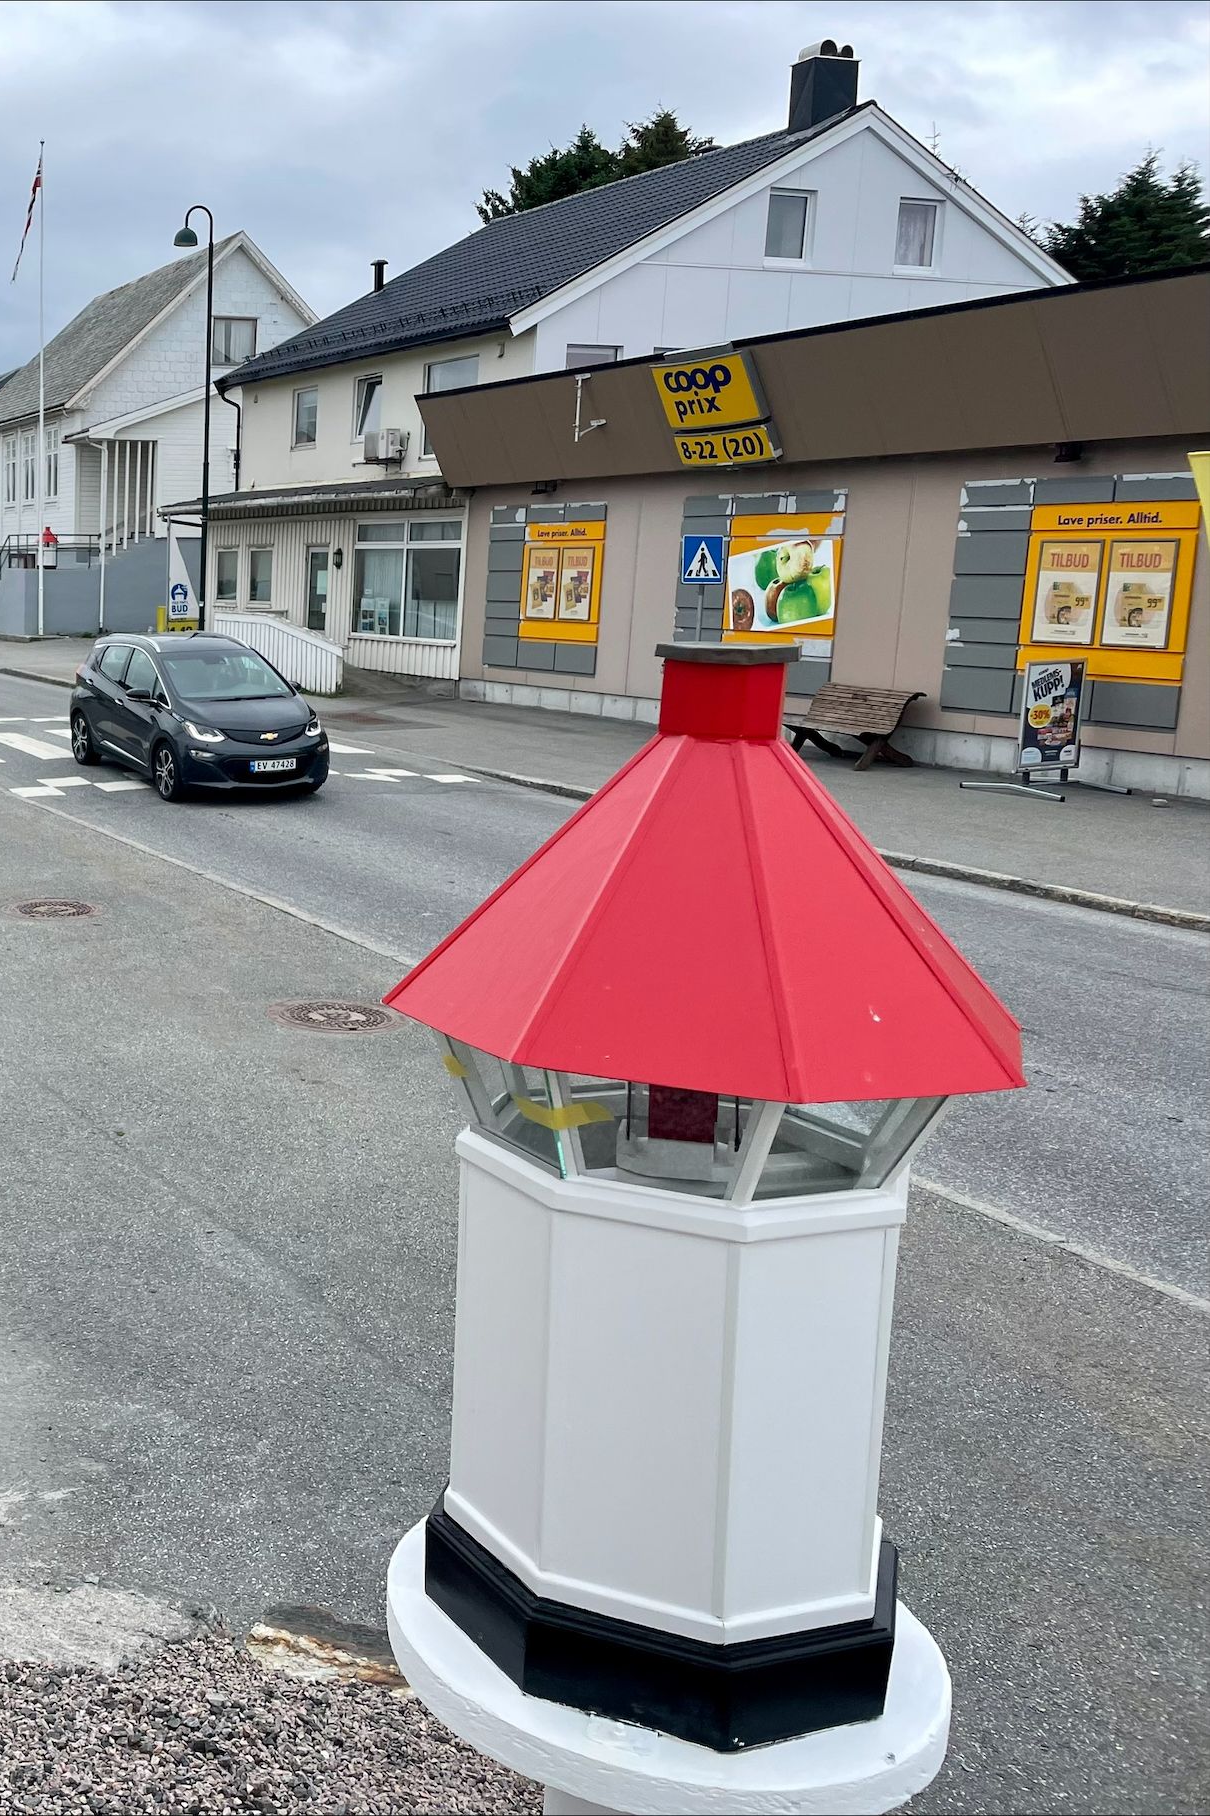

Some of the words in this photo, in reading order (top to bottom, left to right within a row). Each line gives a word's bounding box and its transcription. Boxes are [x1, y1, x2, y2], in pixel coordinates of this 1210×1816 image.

[663, 364, 732, 394] coop
[674, 390, 722, 423] prix
[680, 440, 718, 460] 8-22
[722, 432, 764, 459] (20)
[1058, 515, 1083, 526] Lave
[1086, 513, 1123, 527] priser.
[1126, 511, 1163, 524] Alltid.
[1050, 552, 1089, 568] TILBUD
[1119, 553, 1162, 568] TILBUD
[171, 604, 188, 613] BUD
[1033, 674, 1065, 702] KUPP!
[257, 762, 268, 770] EV
[271, 759, 295, 769] 47428
